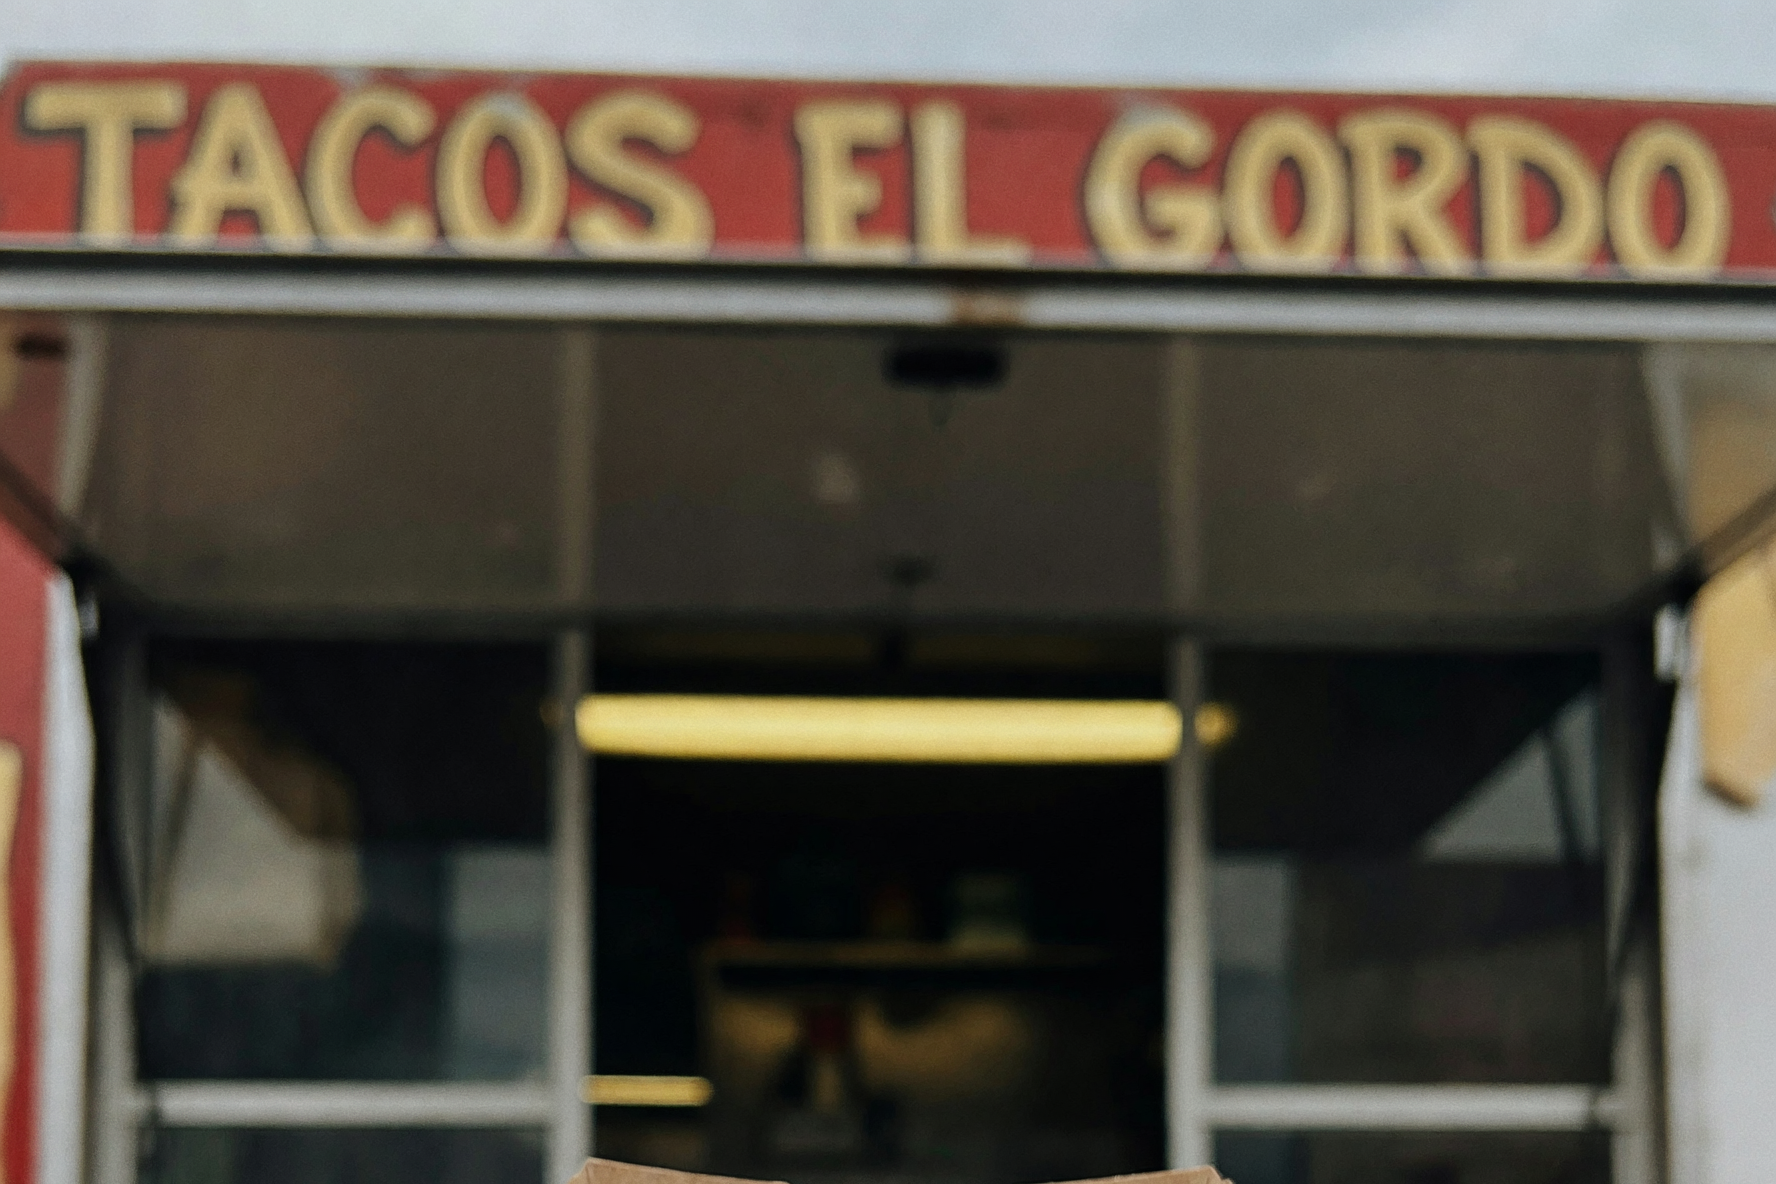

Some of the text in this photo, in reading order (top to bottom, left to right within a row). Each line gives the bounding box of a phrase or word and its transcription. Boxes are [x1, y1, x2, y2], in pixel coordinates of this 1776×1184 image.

[25, 81, 1731, 280] TACOS EL GORDO
